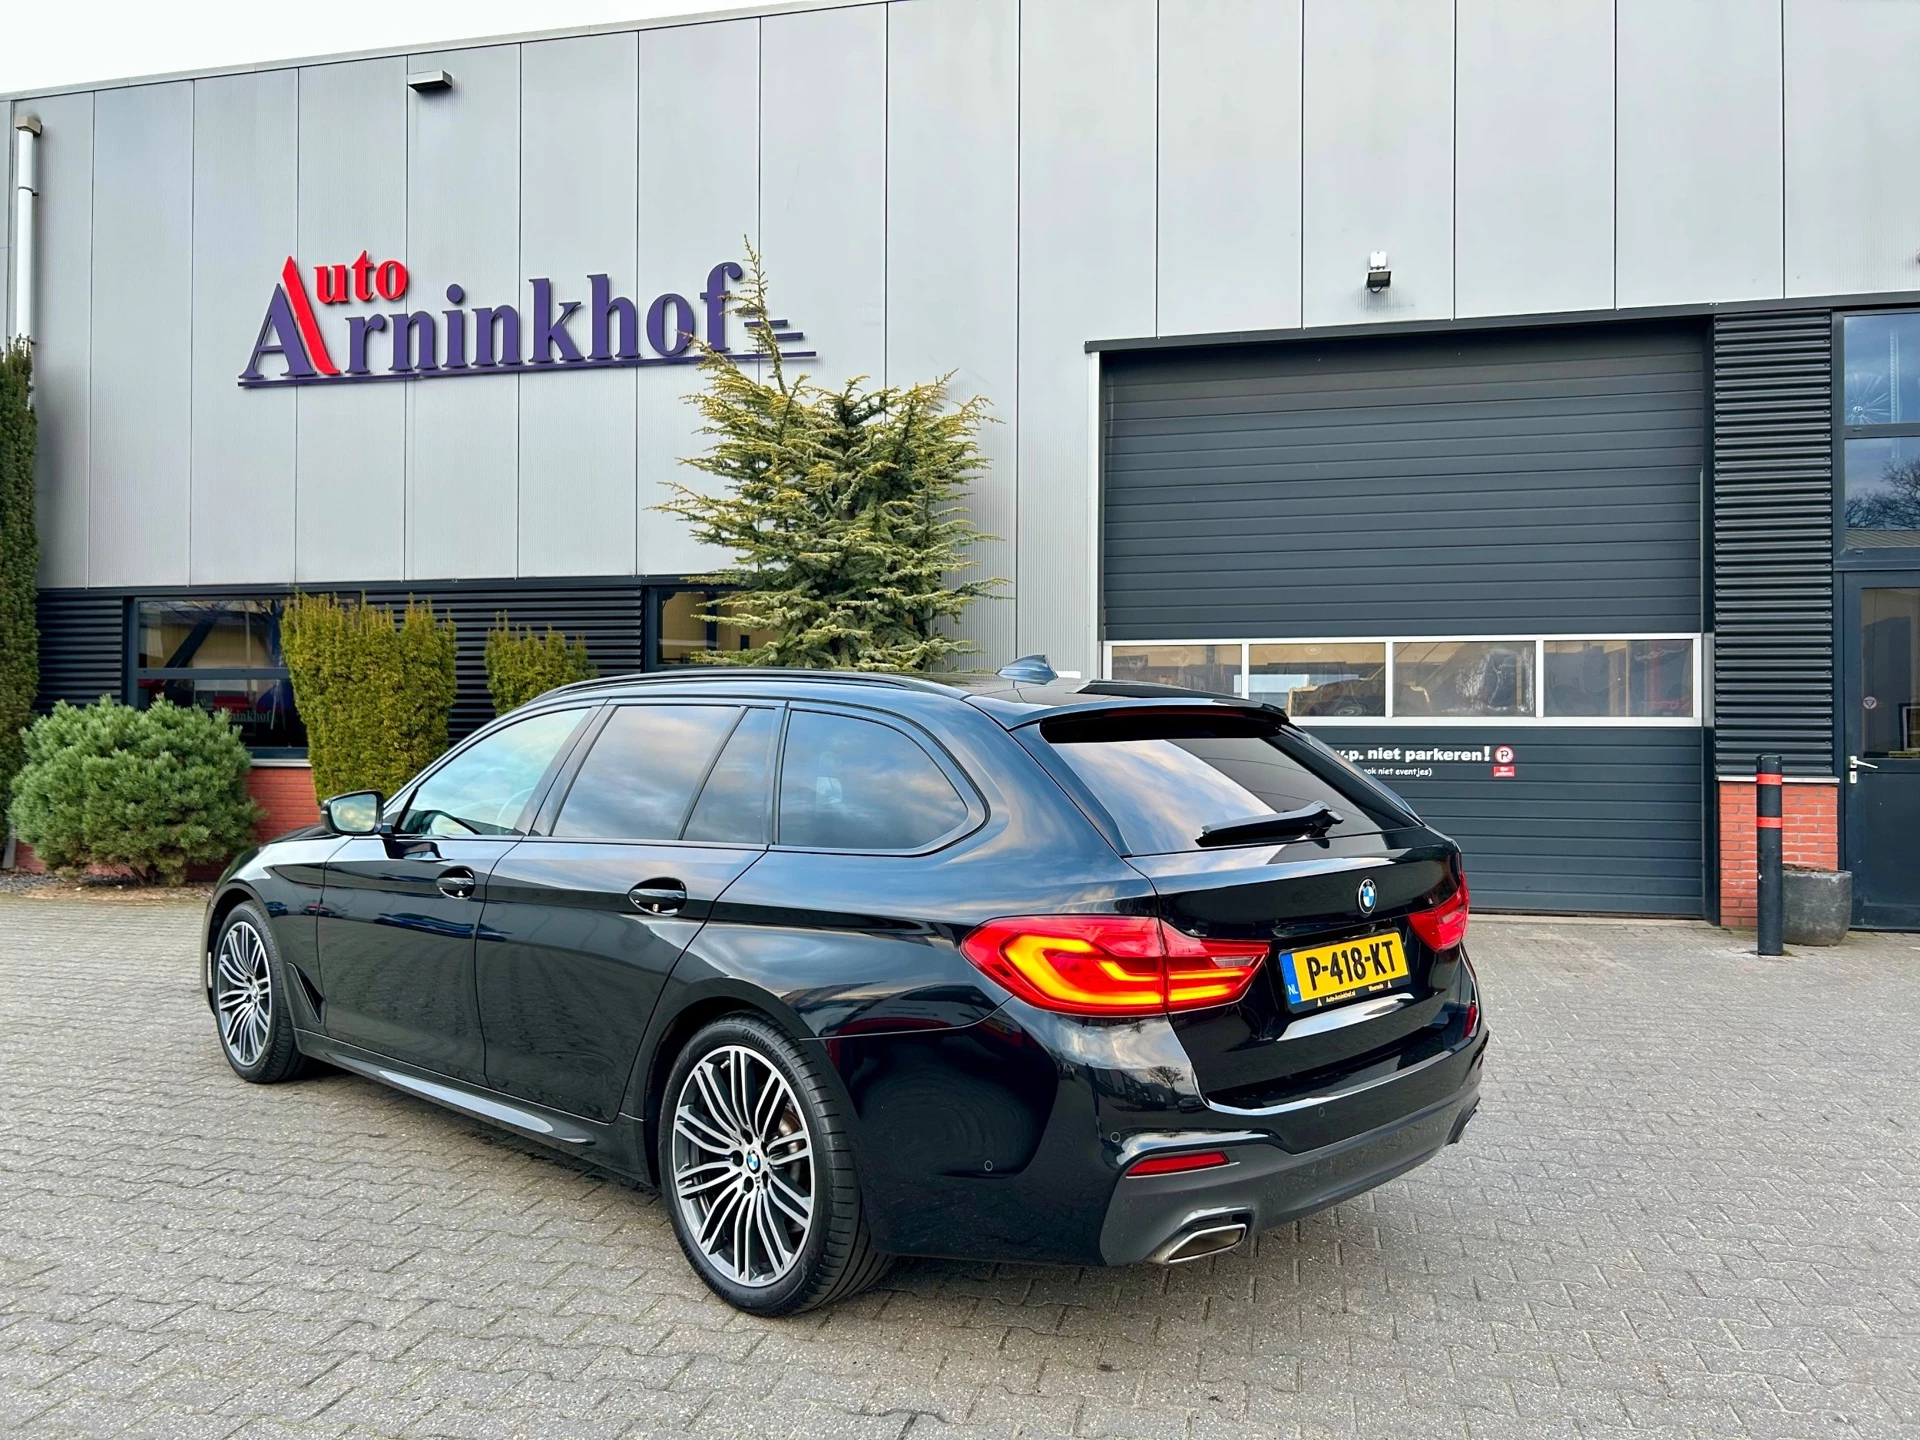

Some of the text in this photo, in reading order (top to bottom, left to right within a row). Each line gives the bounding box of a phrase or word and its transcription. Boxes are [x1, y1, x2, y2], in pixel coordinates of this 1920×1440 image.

[238, 261, 743, 379] Arninkhof
[1368, 747, 1400, 760] niet
[1405, 745, 1490, 763] parkeren!
[1378, 767, 1393, 775] niet
[1306, 940, 1396, 991] P-418-KT
[1288, 984, 1299, 995] NL
